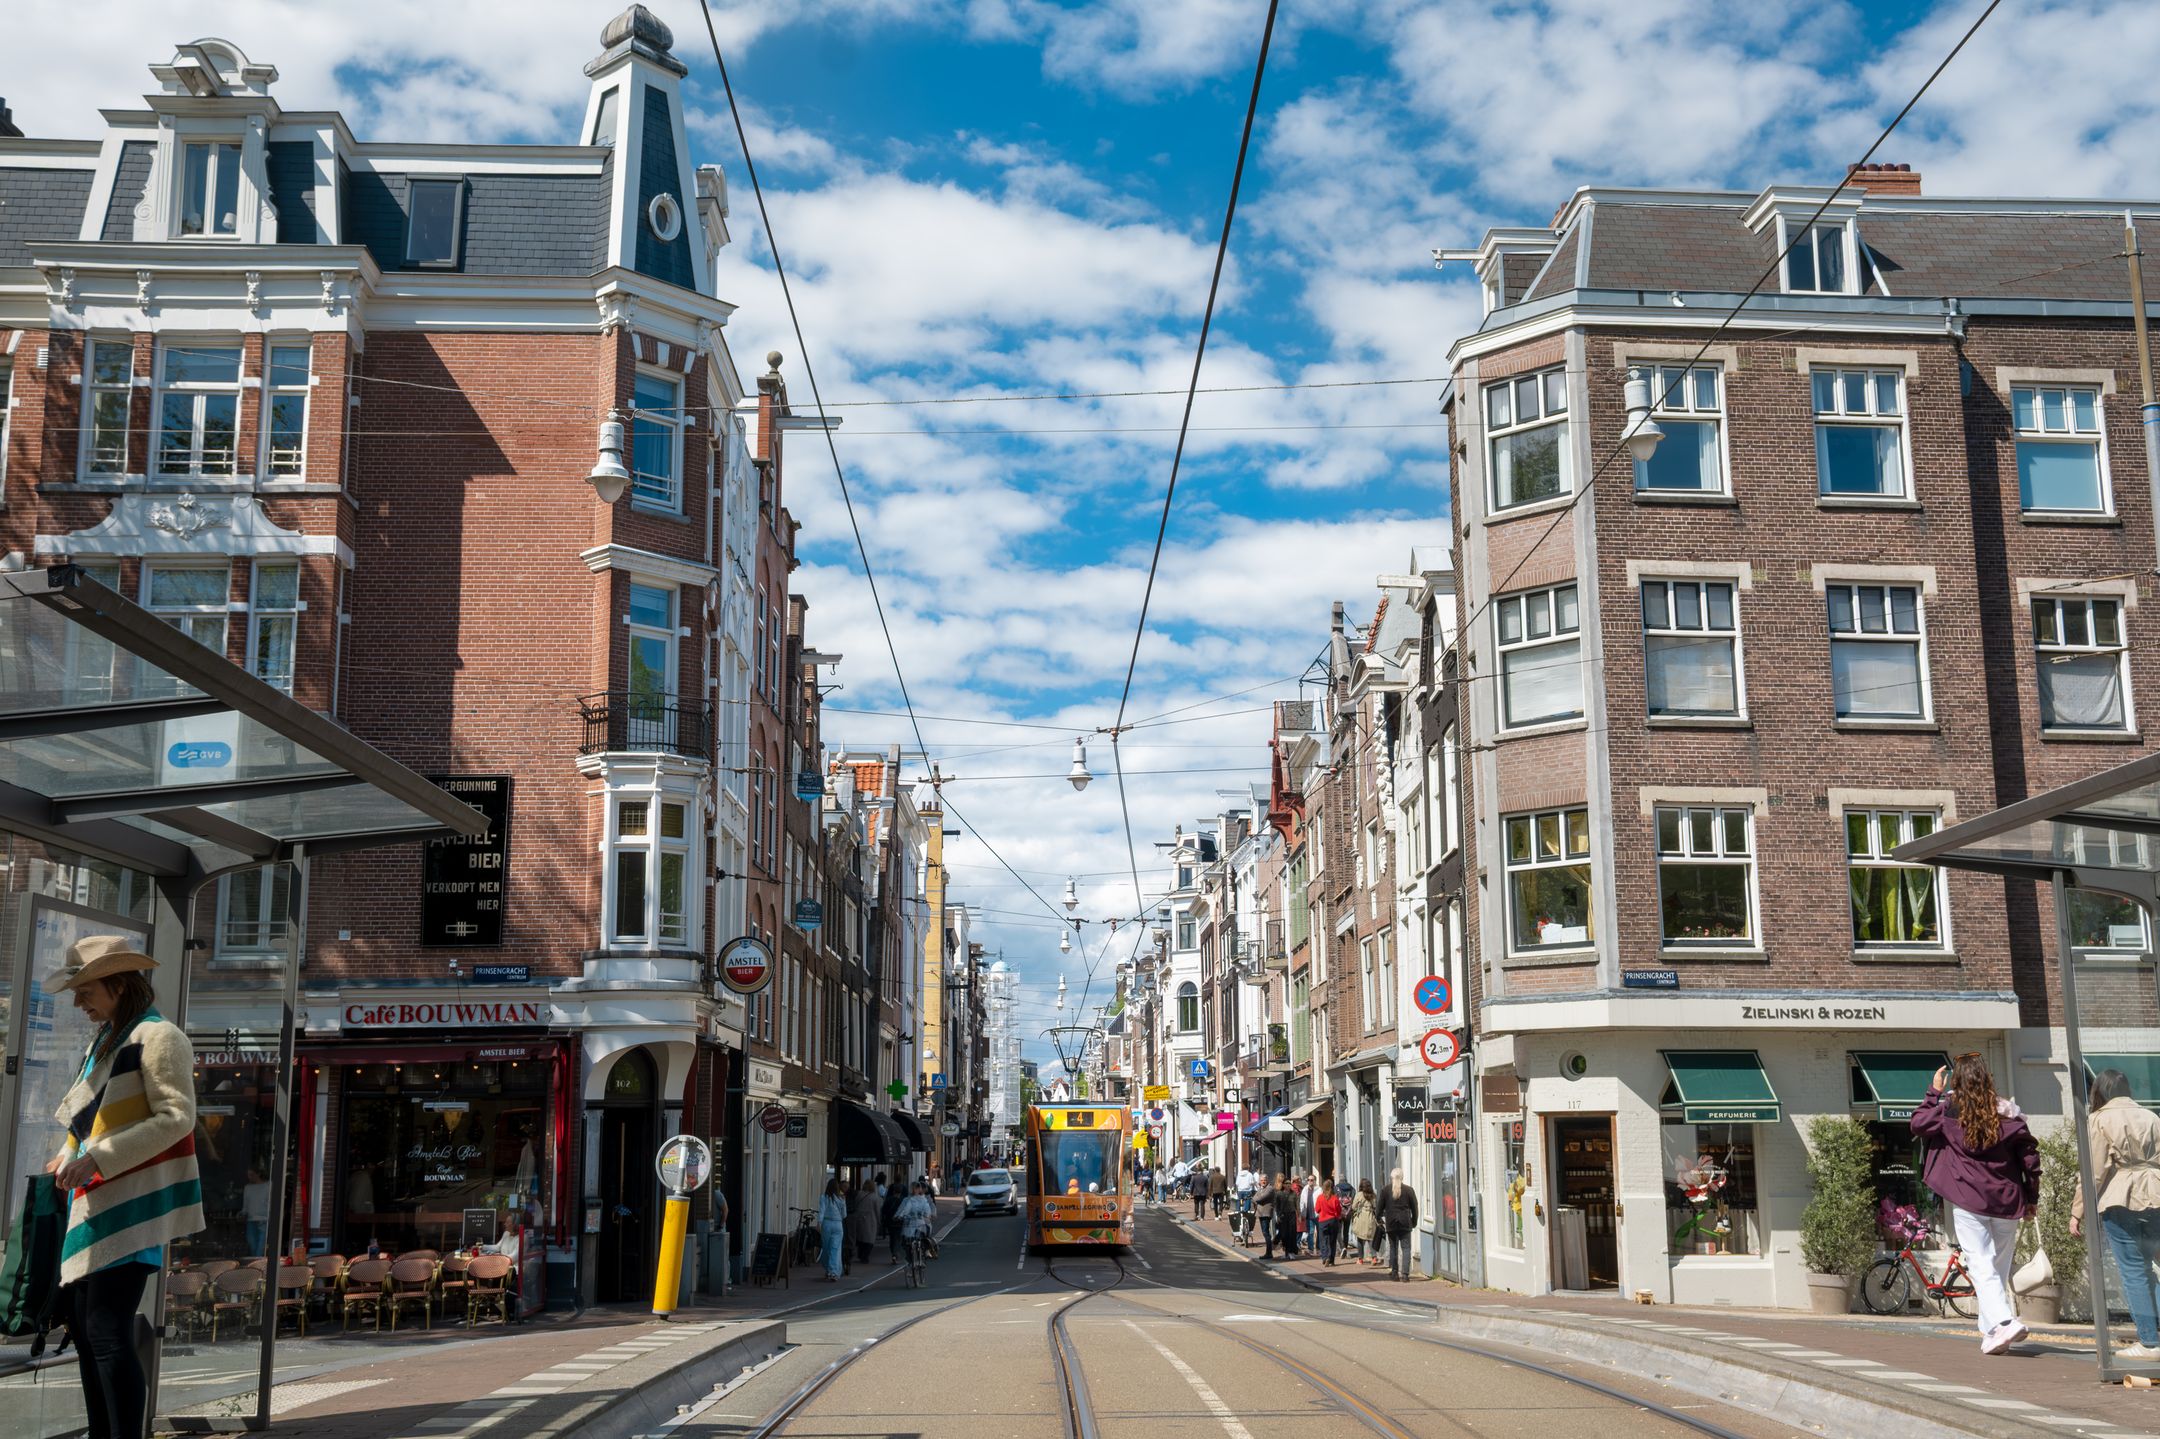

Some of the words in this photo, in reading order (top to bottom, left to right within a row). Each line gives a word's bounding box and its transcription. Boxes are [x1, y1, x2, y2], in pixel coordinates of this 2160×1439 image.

[199, 751, 222, 759] GVB
[469, 853, 501, 869] BIER
[426, 881, 475, 893] VERKOOPT
[479, 881, 500, 893] MEN
[477, 899, 499, 910] HIER
[728, 957, 763, 966] AMSTEL
[475, 967, 527, 975] PRINSENGRACHT
[1626, 972, 1675, 980] PRINSENGRACHT
[345, 1004, 395, 1025] Café
[399, 1003, 540, 1024] BOUWMAN
[1741, 1006, 1814, 1020] ZIELINSKI
[1817, 1006, 1830, 1020] &
[1834, 1007, 1885, 1020] ROZEN
[479, 1048, 507, 1057] AMSTEL
[508, 1048, 526, 1056] BIER
[205, 1052, 281, 1065] BOUWMA
[616, 1080, 631, 1088] 302
[1397, 1099, 1424, 1109] KAJA
[1568, 1101, 1582, 1109] 117
[1077, 1112, 1083, 1124] 4
[1889, 1109, 1913, 1118] ZIELIN
[1425, 1118, 1457, 1139] hotel
[457, 1145, 482, 1160] Bier
[424, 1174, 465, 1182] BOUWMAN
